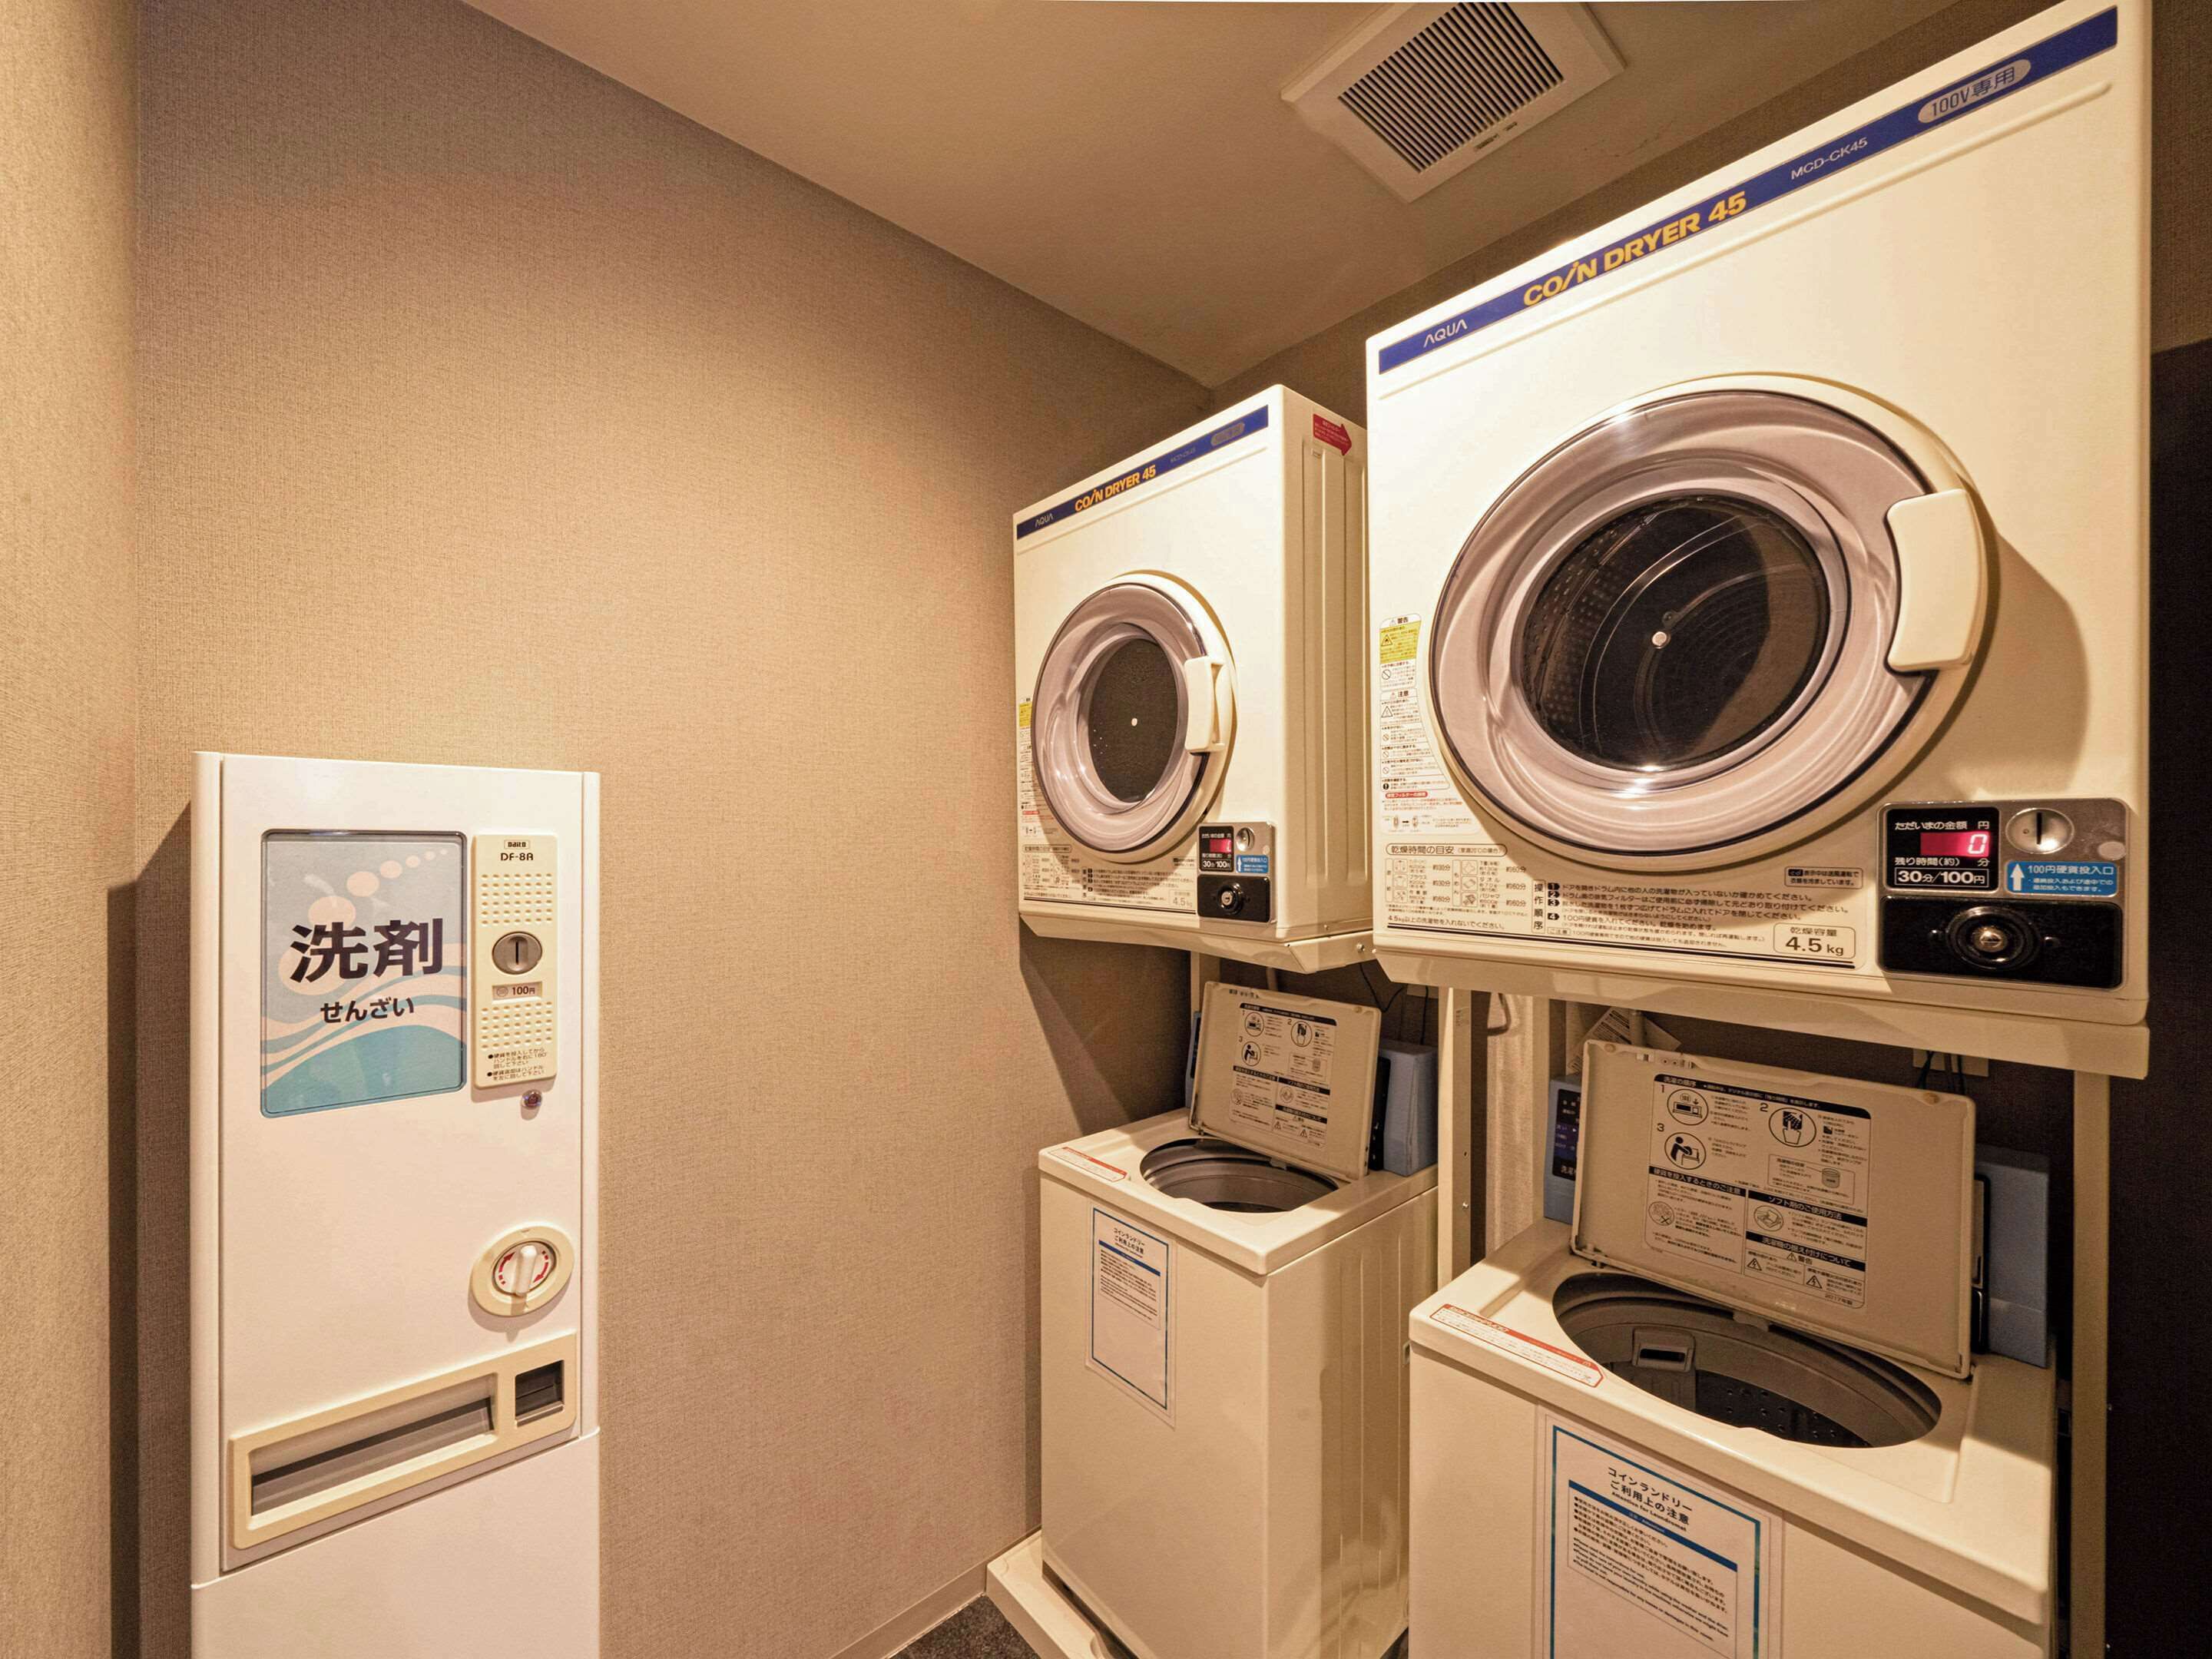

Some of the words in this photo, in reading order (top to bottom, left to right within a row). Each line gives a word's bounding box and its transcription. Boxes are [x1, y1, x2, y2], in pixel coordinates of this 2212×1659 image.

[1931, 67, 2015, 118] 100V専用
[1790, 137, 1869, 180] MCD-CK45
[1604, 212, 1701, 272] DRYER
[1707, 191, 1747, 222] 45
[1423, 319, 1468, 348] AQUA
[1035, 513, 1053, 528] AQUA
[1104, 472, 1140, 499] DRYER
[1142, 464, 1156, 480] 45
[1895, 821, 1968, 830] ただいまの金額
[1978, 821, 1990, 830] 円
[1391, 846, 1455, 855] 乾燥時間の目安
[1968, 833, 1988, 854] 0
[500, 853, 534, 861] DF-8A
[1978, 858, 1990, 867] 分
[1898, 870, 1985, 884] 30分/100円
[2028, 866, 2114, 875] 100円硬貨投入口
[1790, 927, 1837, 937] 乾燥容量
[290, 918, 444, 983] 洗剤
[1785, 937, 1823, 952] 4.5
[1827, 945, 1844, 956] kg
[512, 986, 535, 995] 100円
[320, 996, 415, 1024] せんざい
[1760, 1102, 1768, 1112] 2
[1657, 1123, 1665, 1132] 3
[1608, 1467, 1693, 1512] コインランドリー
[1611, 1480, 1690, 1525] ご利用上の注意
